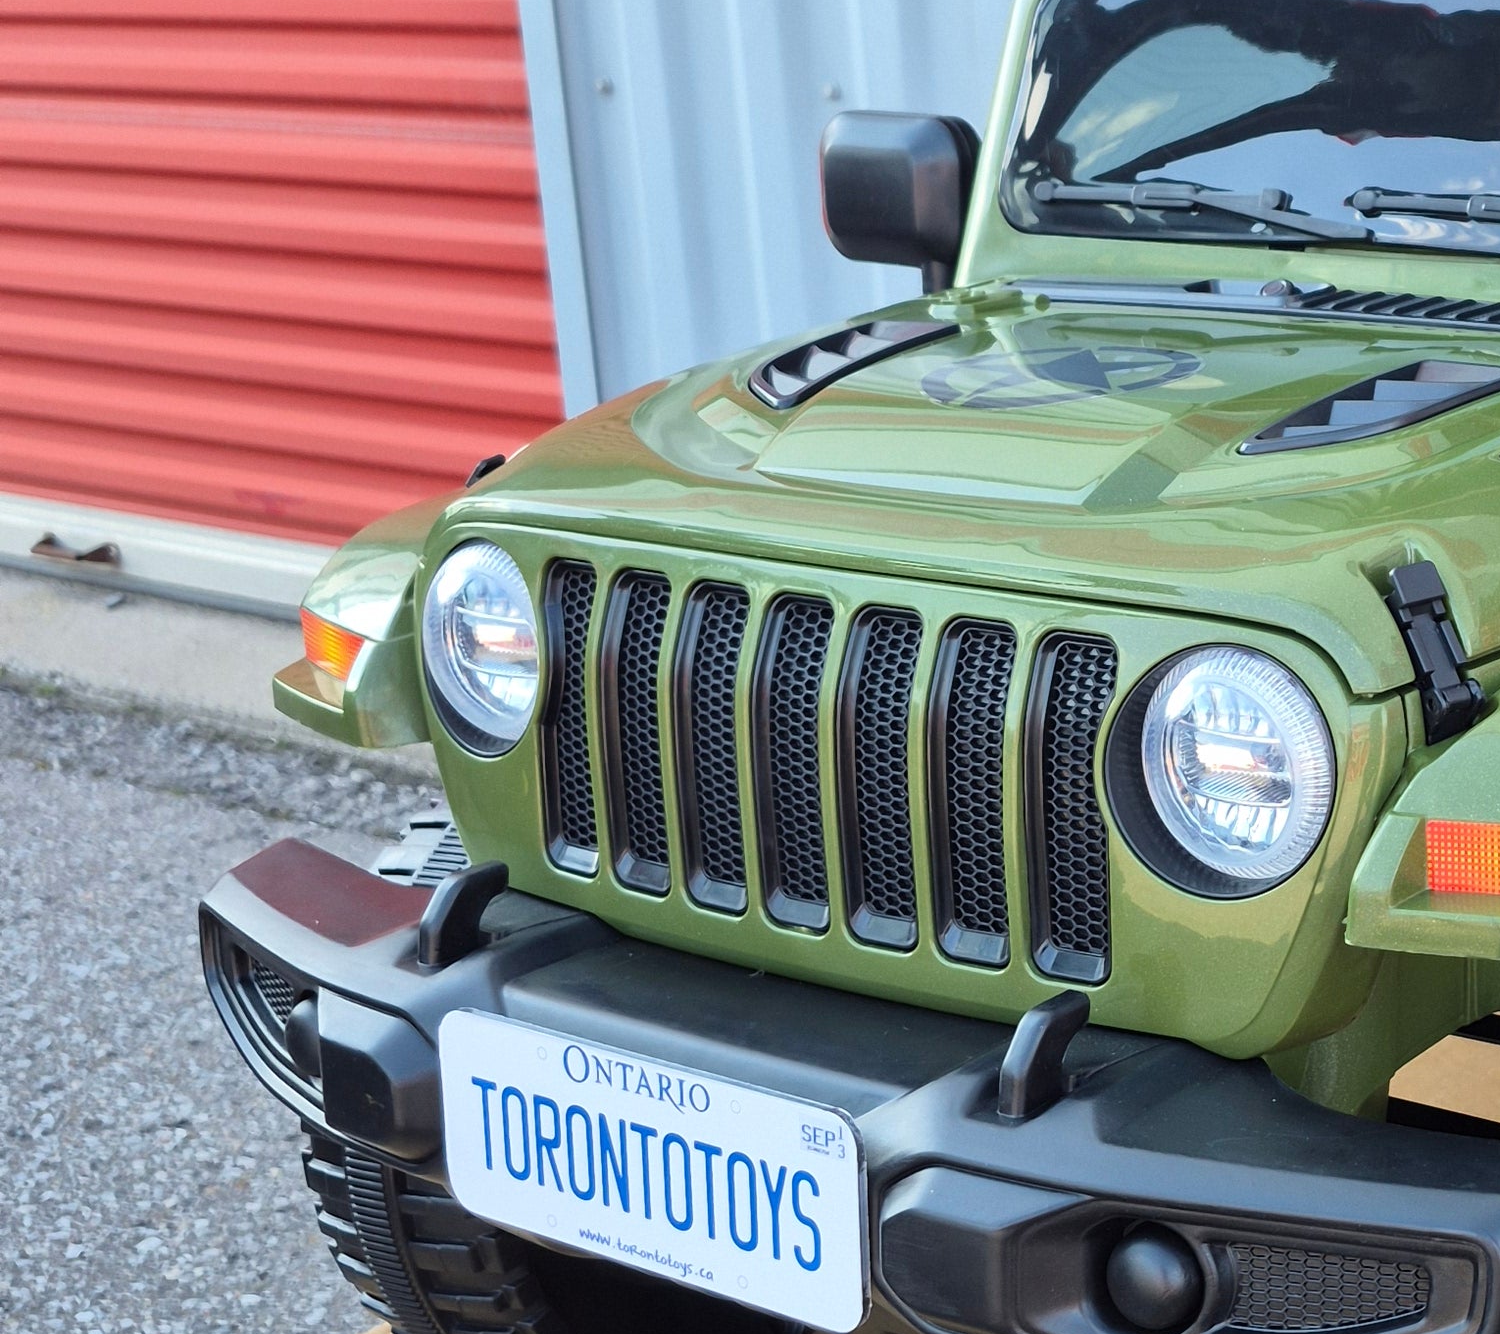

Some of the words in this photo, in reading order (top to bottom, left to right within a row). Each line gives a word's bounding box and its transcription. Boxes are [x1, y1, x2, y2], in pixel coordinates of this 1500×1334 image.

[563, 1044, 711, 1114] ONTARIO
[801, 1123, 836, 1148] SEP
[471, 1076, 822, 1272] TORONTOTOYS
